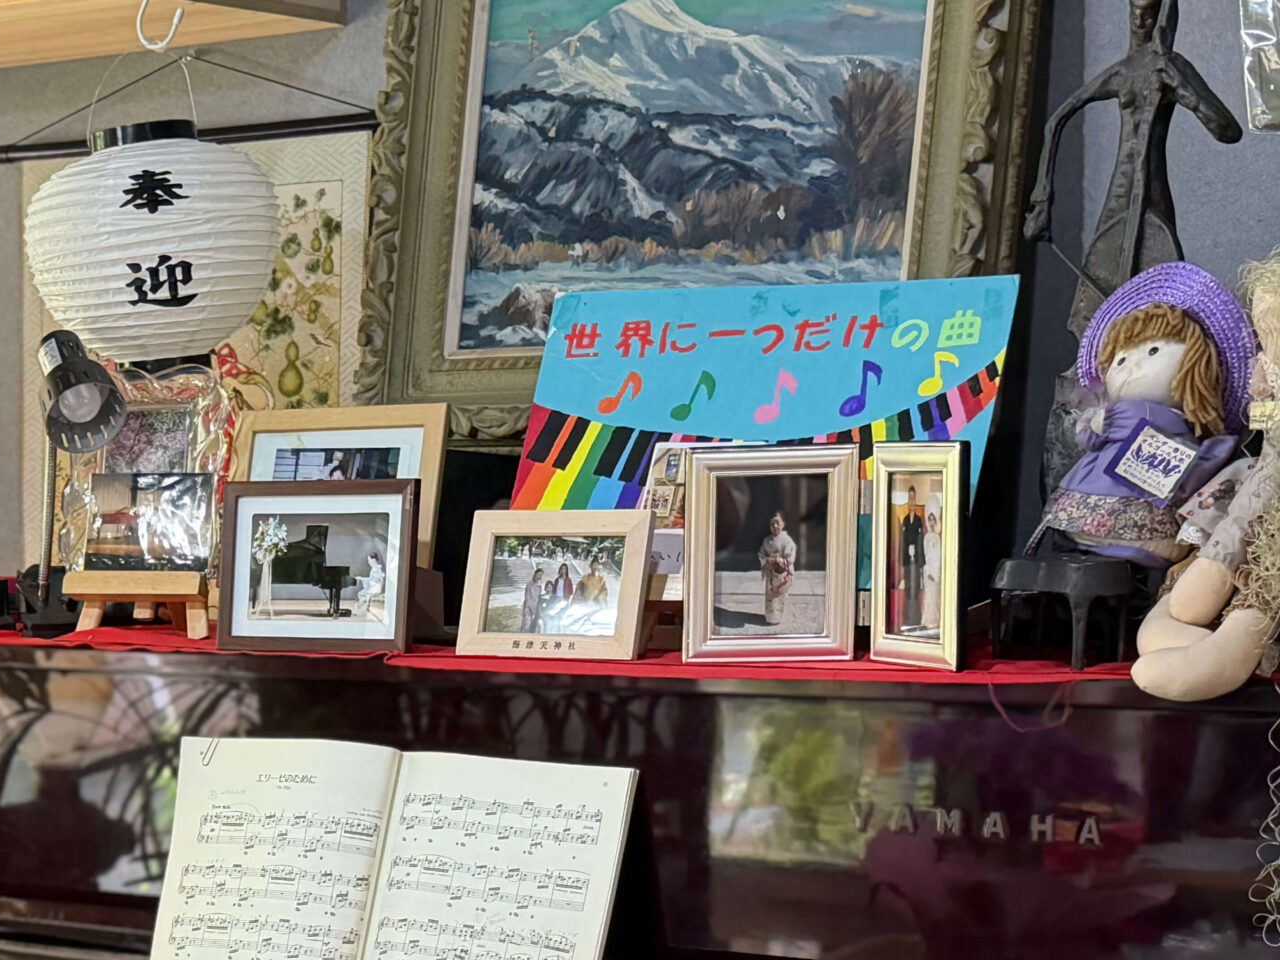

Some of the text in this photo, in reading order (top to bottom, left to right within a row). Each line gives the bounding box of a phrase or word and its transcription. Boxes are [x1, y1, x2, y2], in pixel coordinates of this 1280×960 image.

[119, 170, 199, 307] 奉迎
[563, 308, 982, 360] 世界に一つだけの曲
[255, 773, 318, 785] エリーゼのために
[849, 802, 1103, 847] YAMAHA
